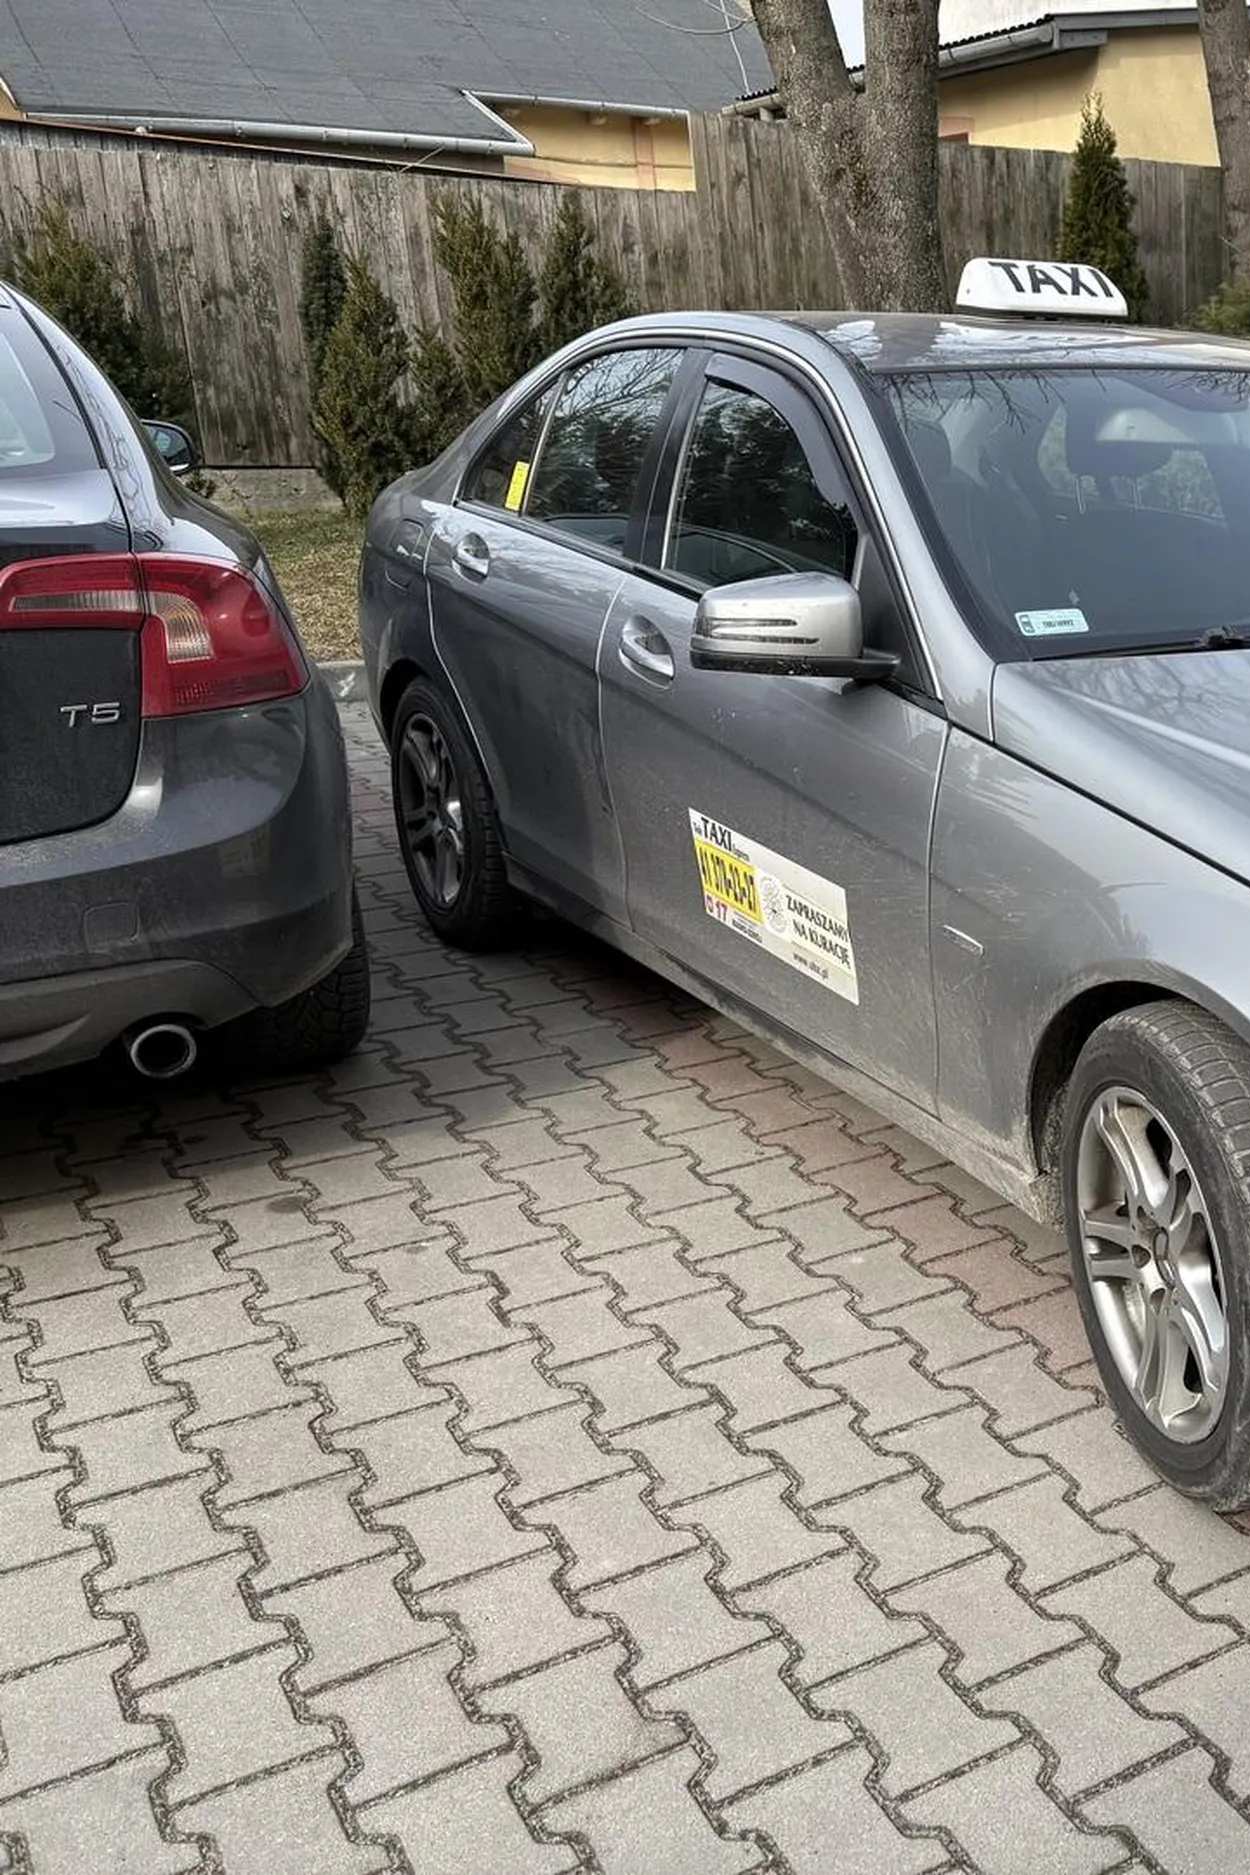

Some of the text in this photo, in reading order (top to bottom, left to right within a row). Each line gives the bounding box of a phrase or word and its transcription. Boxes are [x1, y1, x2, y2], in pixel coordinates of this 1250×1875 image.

[987, 261, 1114, 298] TAXI
[60, 702, 120, 728] T5
[701, 816, 732, 852] TAXI
